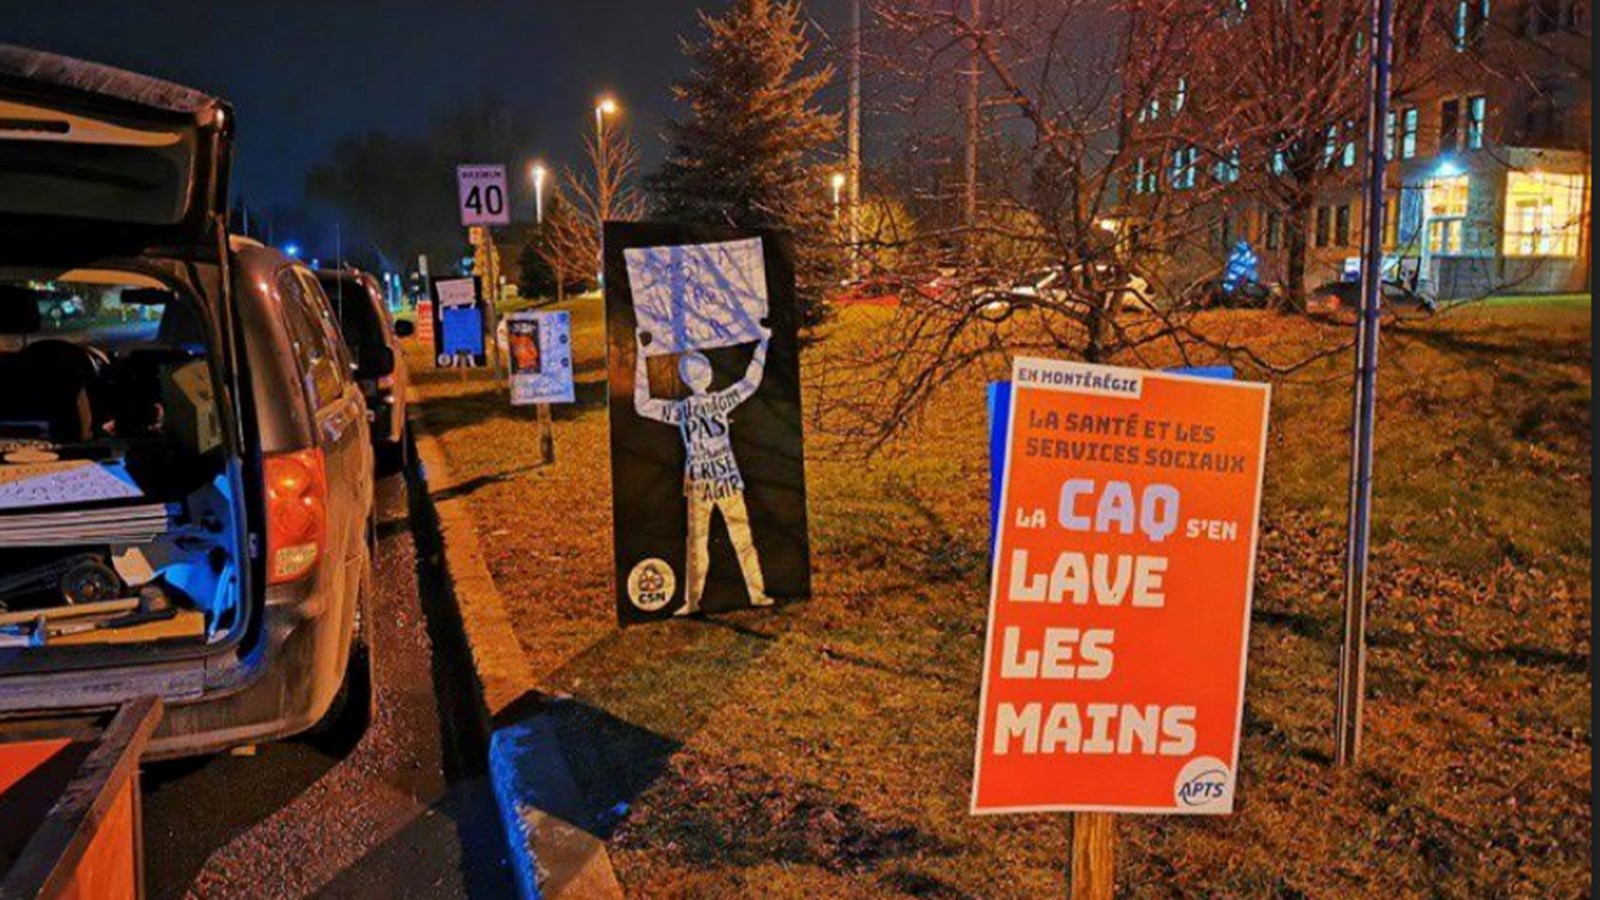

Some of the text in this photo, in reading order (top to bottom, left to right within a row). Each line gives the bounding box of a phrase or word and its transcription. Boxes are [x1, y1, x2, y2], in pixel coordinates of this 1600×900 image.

[464, 185, 504, 215] 40
[1017, 367, 1139, 393] EN MONTÉRÉGIE
[684, 412, 726, 443] PAS
[1029, 409, 1217, 444] LA SANTÉ ET LES
[1025, 437, 1246, 473] SERVICES SOCIAUX
[1015, 477, 1238, 543] LA CAQ S'EN
[1008, 549, 1169, 608] LAVE
[638, 591, 667, 605] CSN
[1000, 626, 1115, 680] LES
[993, 702, 1197, 756] MAINS
[1178, 781, 1225, 800] APTS
